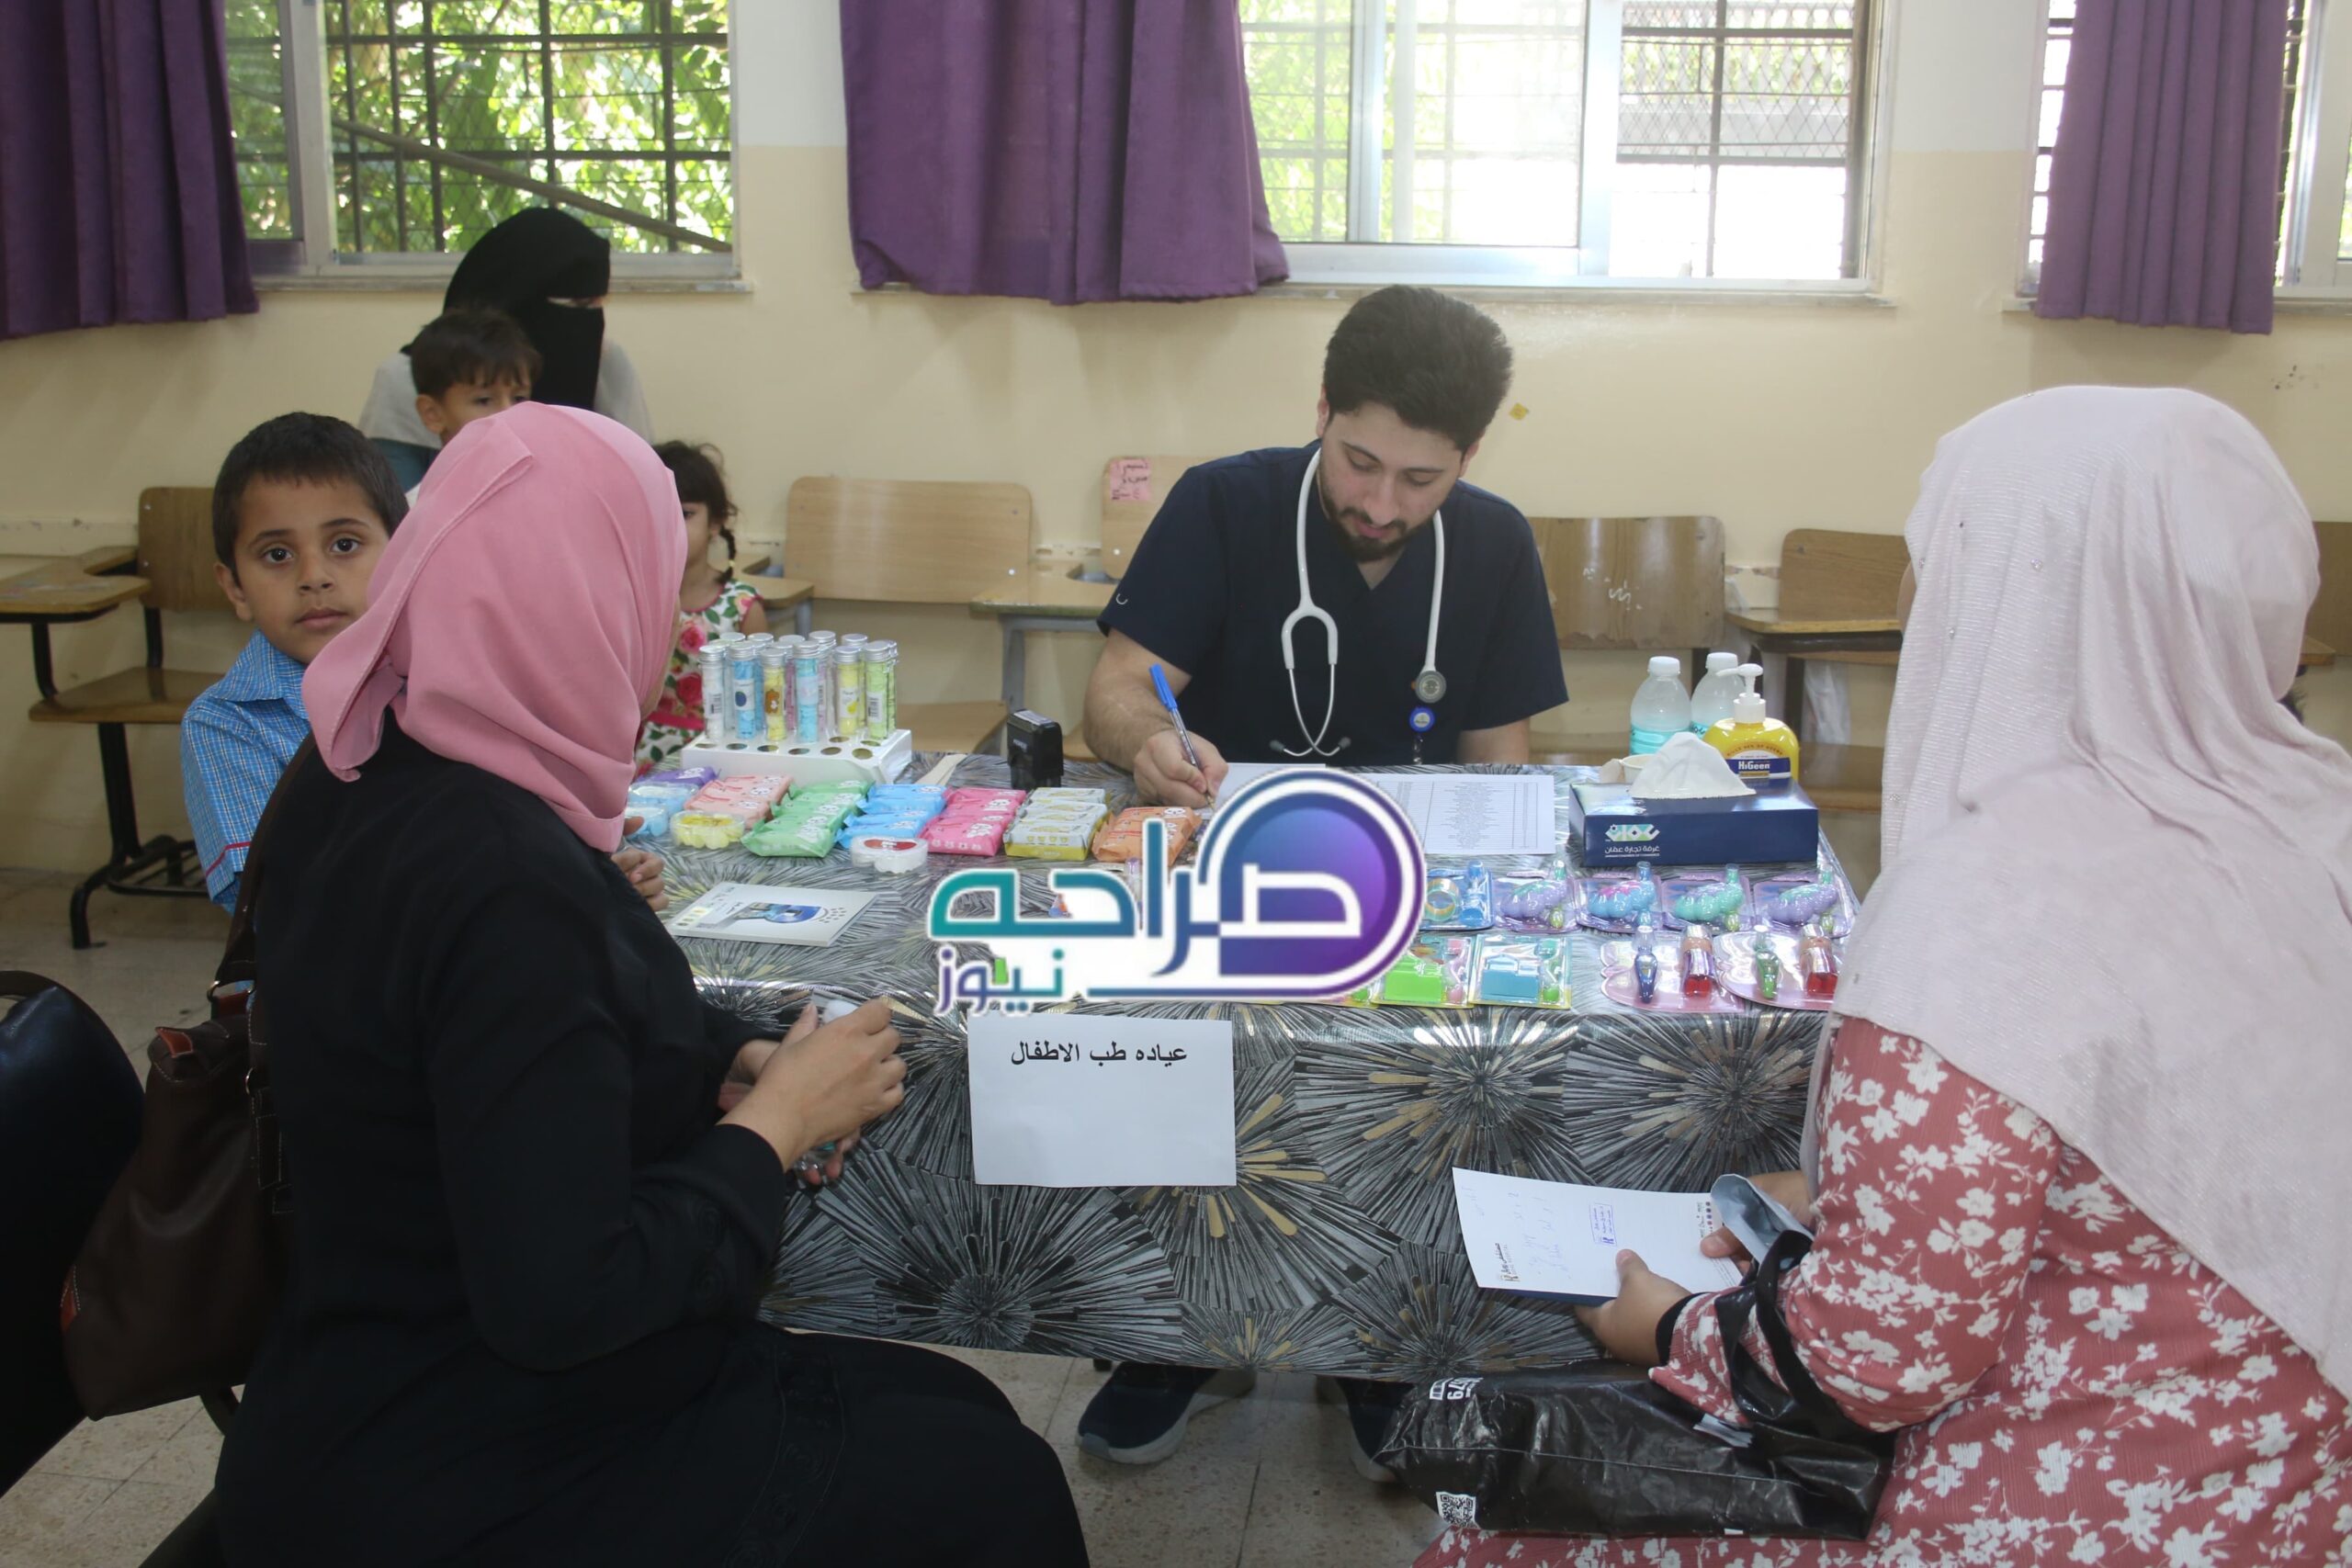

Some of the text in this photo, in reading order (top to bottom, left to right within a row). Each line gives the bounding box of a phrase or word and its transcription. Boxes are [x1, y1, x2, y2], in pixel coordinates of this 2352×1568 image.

[1737, 761, 1770, 771] HiGeen
[1011, 1040, 1187, 1067] عياده طب الاطفال
